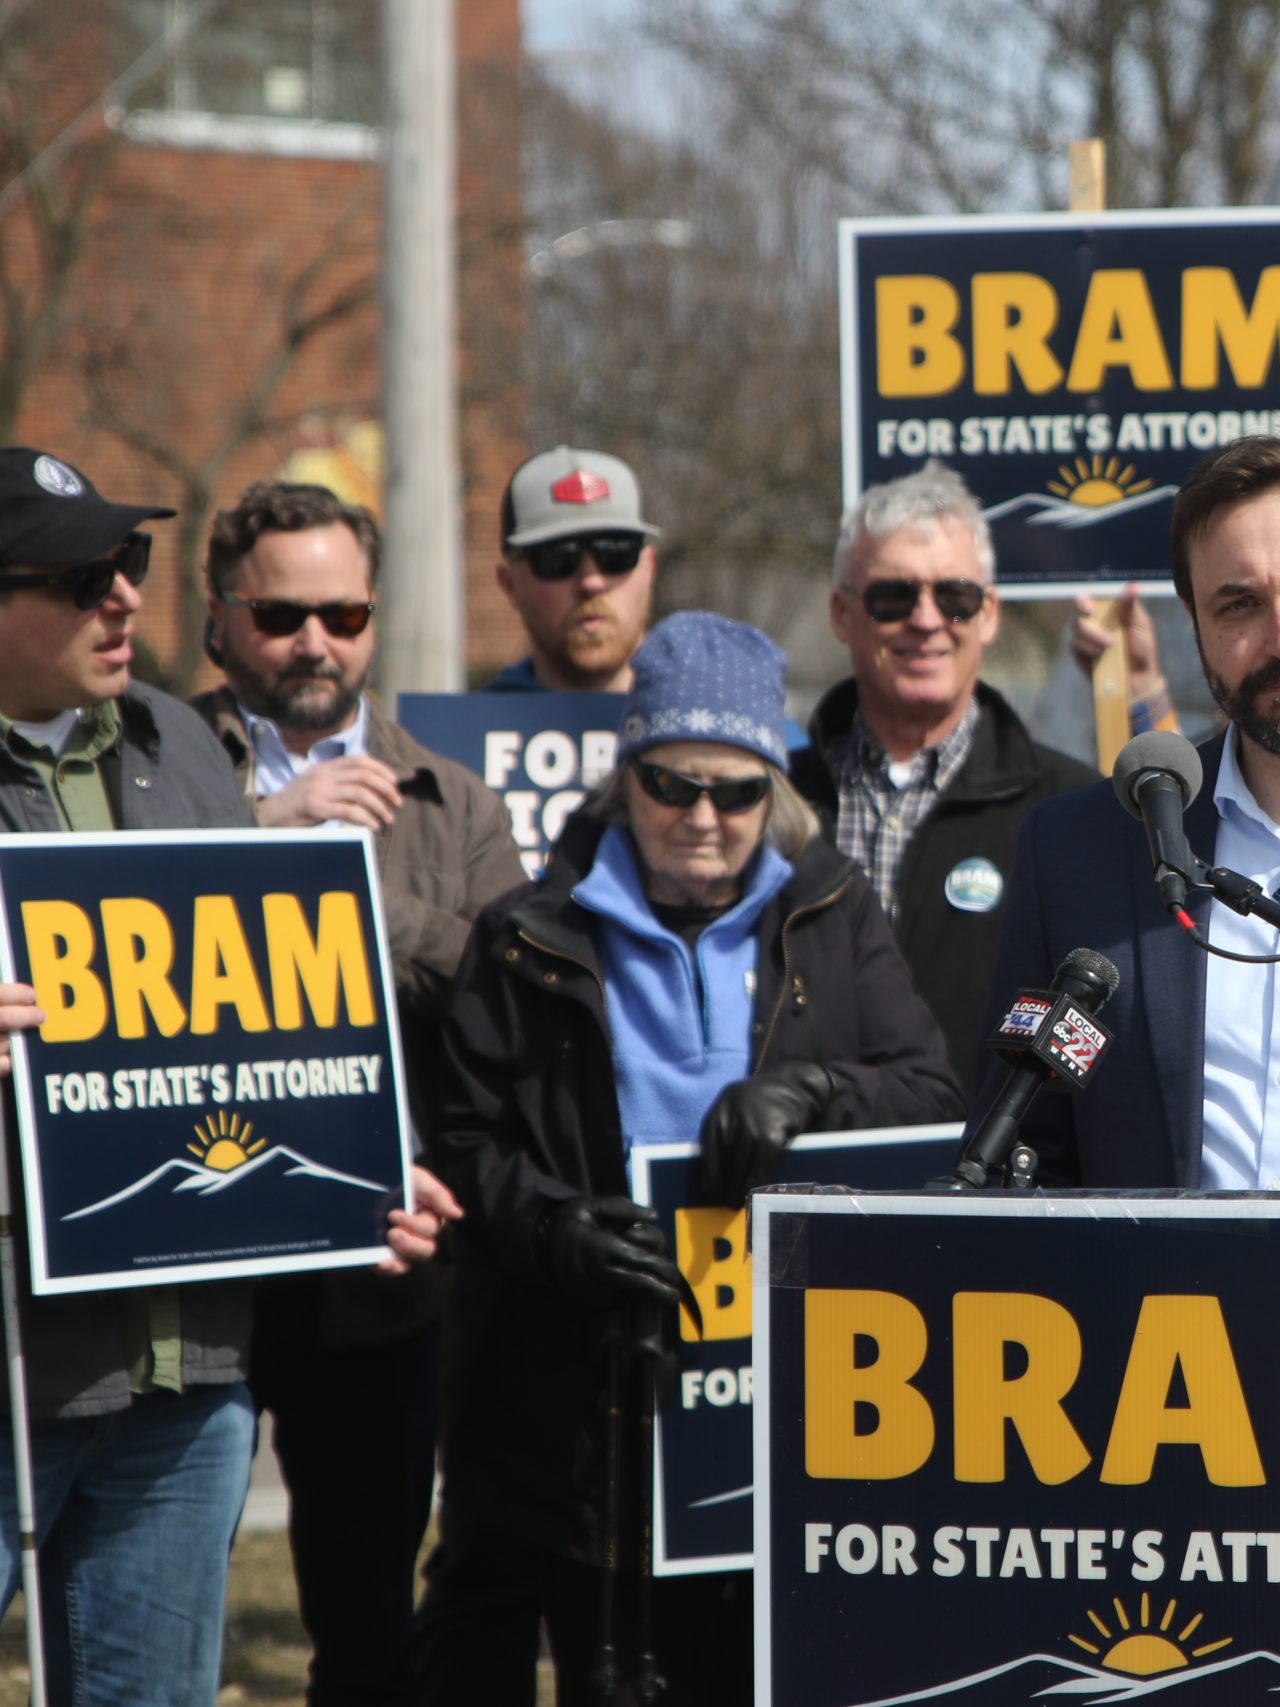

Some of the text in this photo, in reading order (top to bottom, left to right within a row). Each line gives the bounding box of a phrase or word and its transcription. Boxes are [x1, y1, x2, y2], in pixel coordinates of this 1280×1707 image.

[877, 419, 955, 457] FOR
[959, 413, 1112, 455] STATE'S
[21, 891, 377, 1043] BRAM
[1013, 1001, 1048, 1014] LOCAL
[1068, 1012, 1102, 1046] LOCAL
[1050, 1044, 1084, 1077] WVNY
[1053, 1024, 1097, 1072] abc 22
[45, 1054, 382, 1114] FOR STATE'S ATTORNEY
[804, 1523, 919, 1577] FOR
[932, 1526, 1166, 1583] STATE'S
